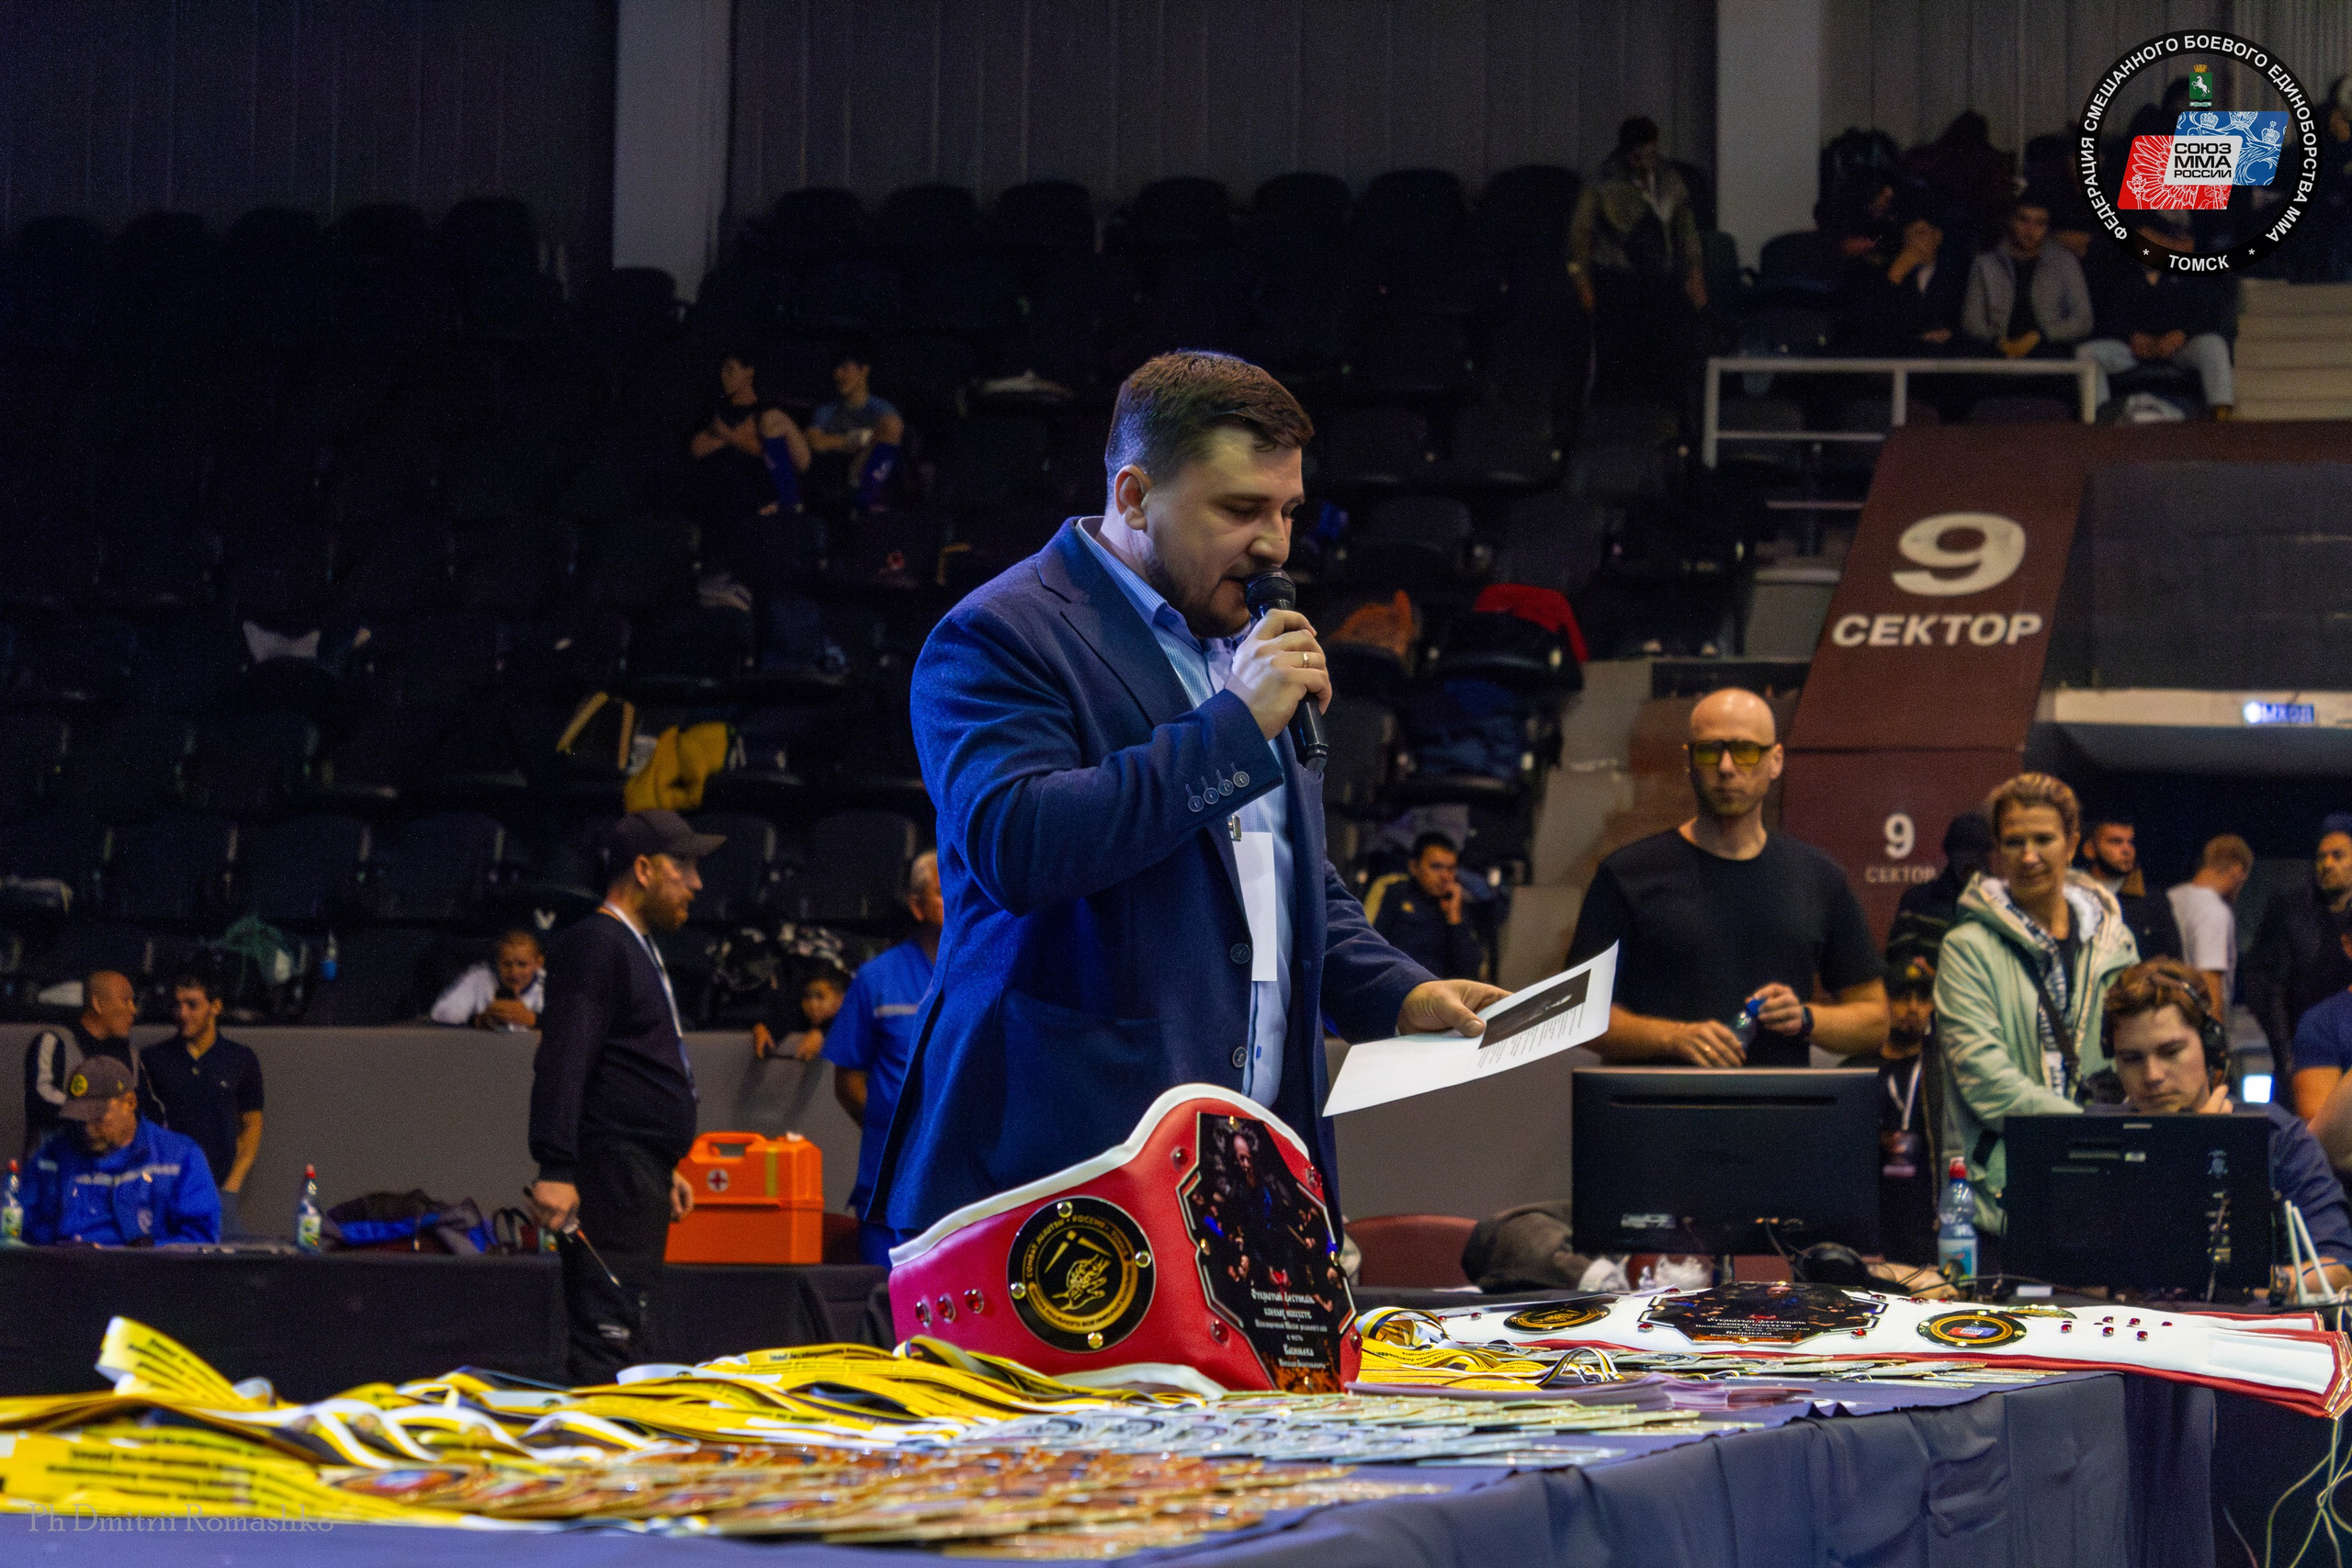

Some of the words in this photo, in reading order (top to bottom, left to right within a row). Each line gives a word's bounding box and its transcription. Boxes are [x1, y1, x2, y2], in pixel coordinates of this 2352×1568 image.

[1890, 512, 2027, 598] 9
[1832, 613, 2042, 648] СЕКТОР
[1884, 813, 1916, 860] 9
